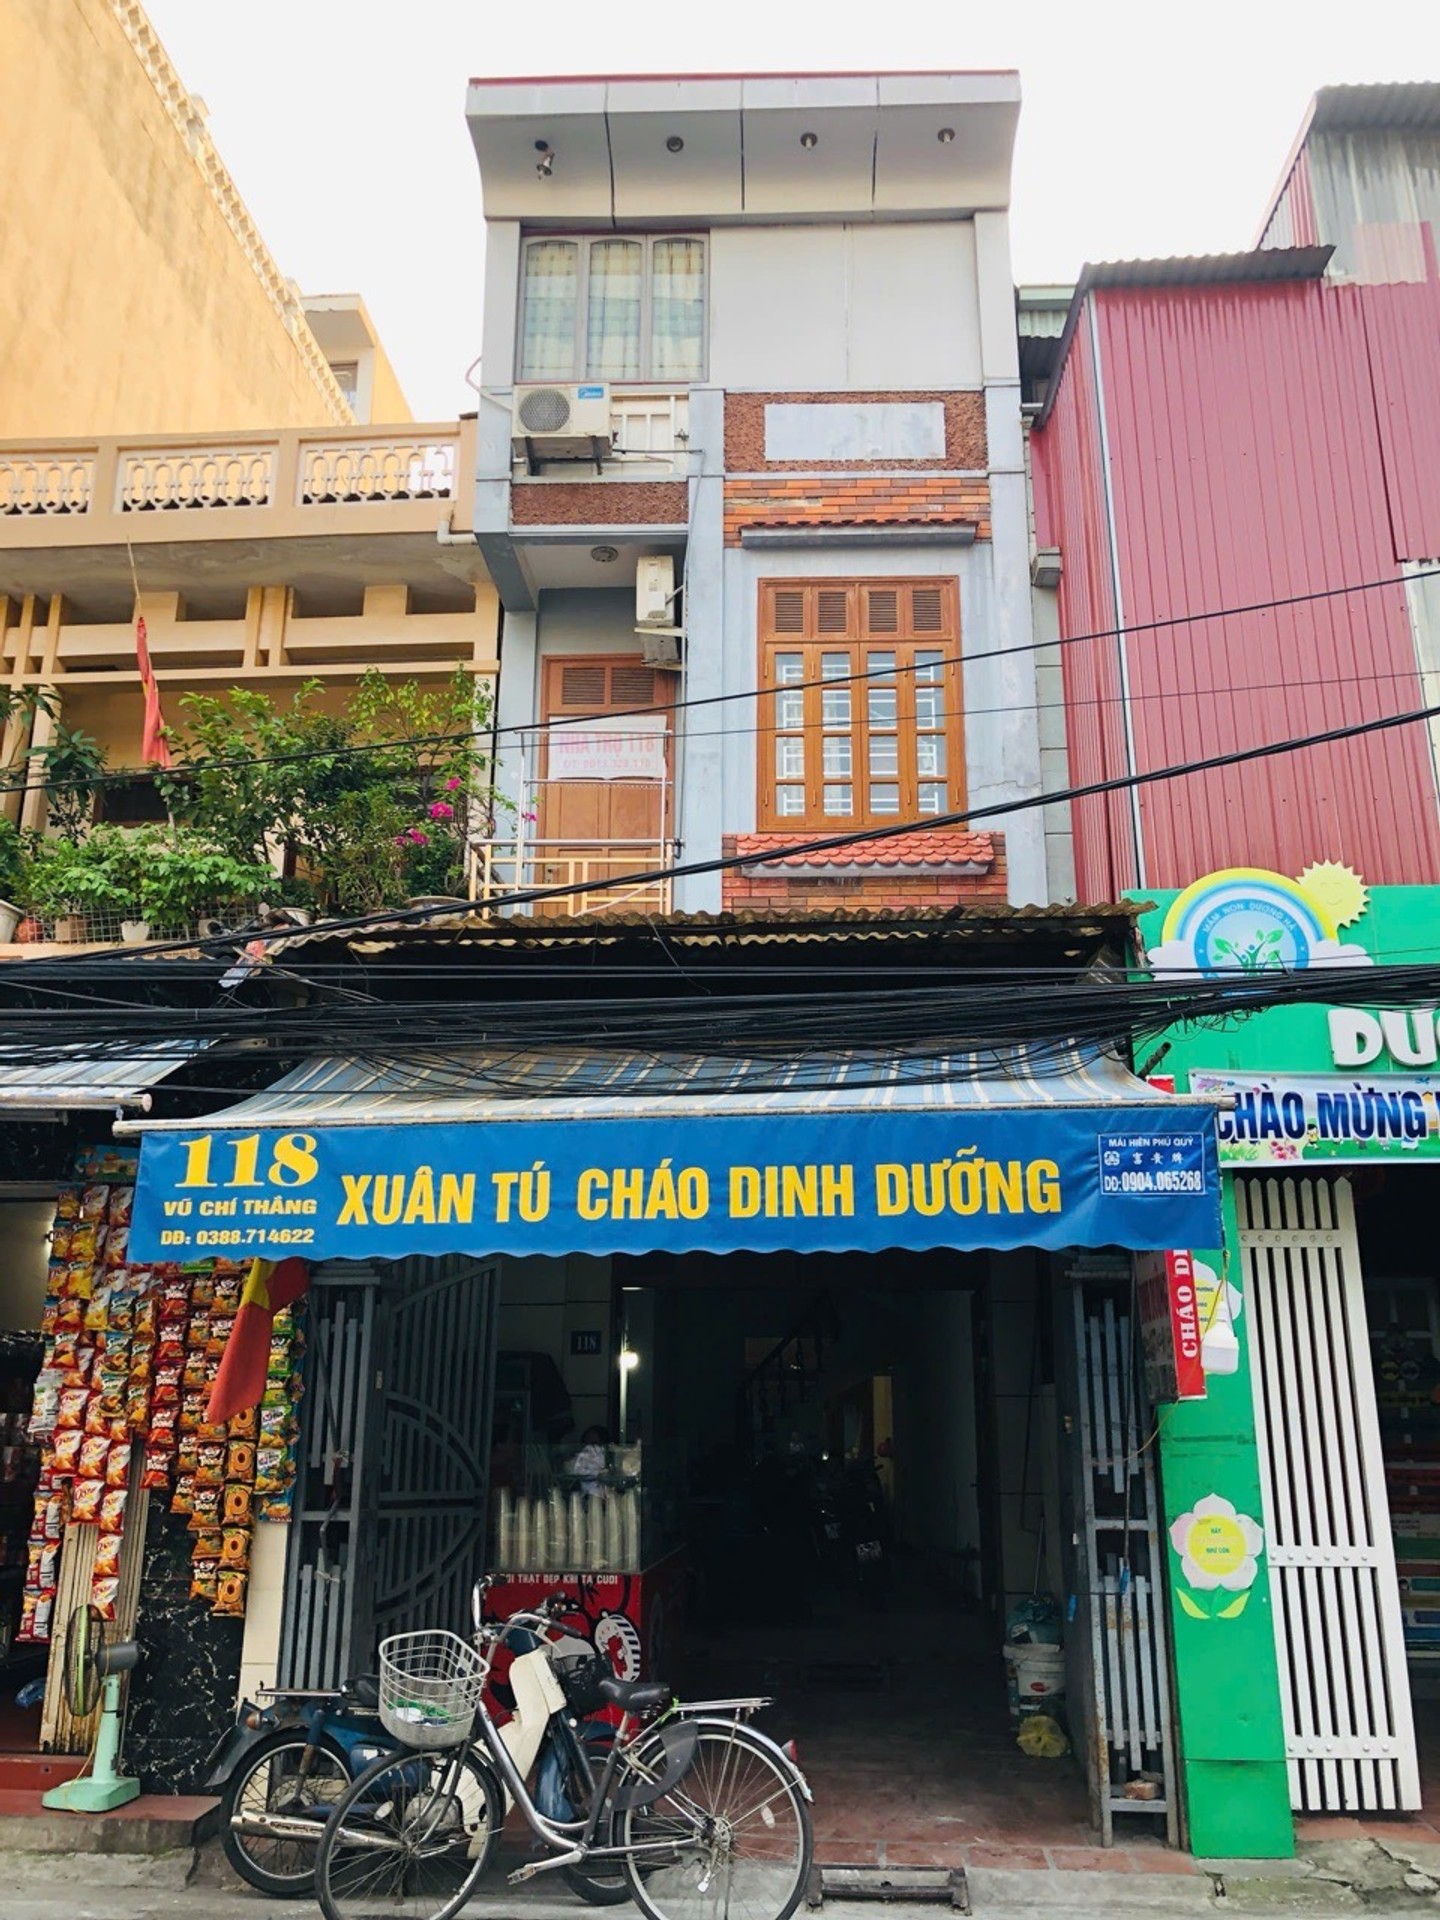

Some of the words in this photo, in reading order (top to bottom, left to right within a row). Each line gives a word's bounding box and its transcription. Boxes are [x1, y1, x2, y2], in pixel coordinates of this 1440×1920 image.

[174, 1133, 319, 1188] 118
[336, 1165, 475, 1226] XUÂN
[492, 1160, 552, 1223] TÚ
[576, 1158, 710, 1220] CHÁO
[729, 1164, 855, 1219] DINH
[875, 1144, 1063, 1217] DƯỠNG
[164, 1197, 193, 1217] VŨ
[199, 1197, 238, 1217] CHÍ
[196, 1228, 315, 1246] 0388.714622
[1176, 1285, 1198, 1358] CHÁO
[577, 1335, 597, 1351] 118
